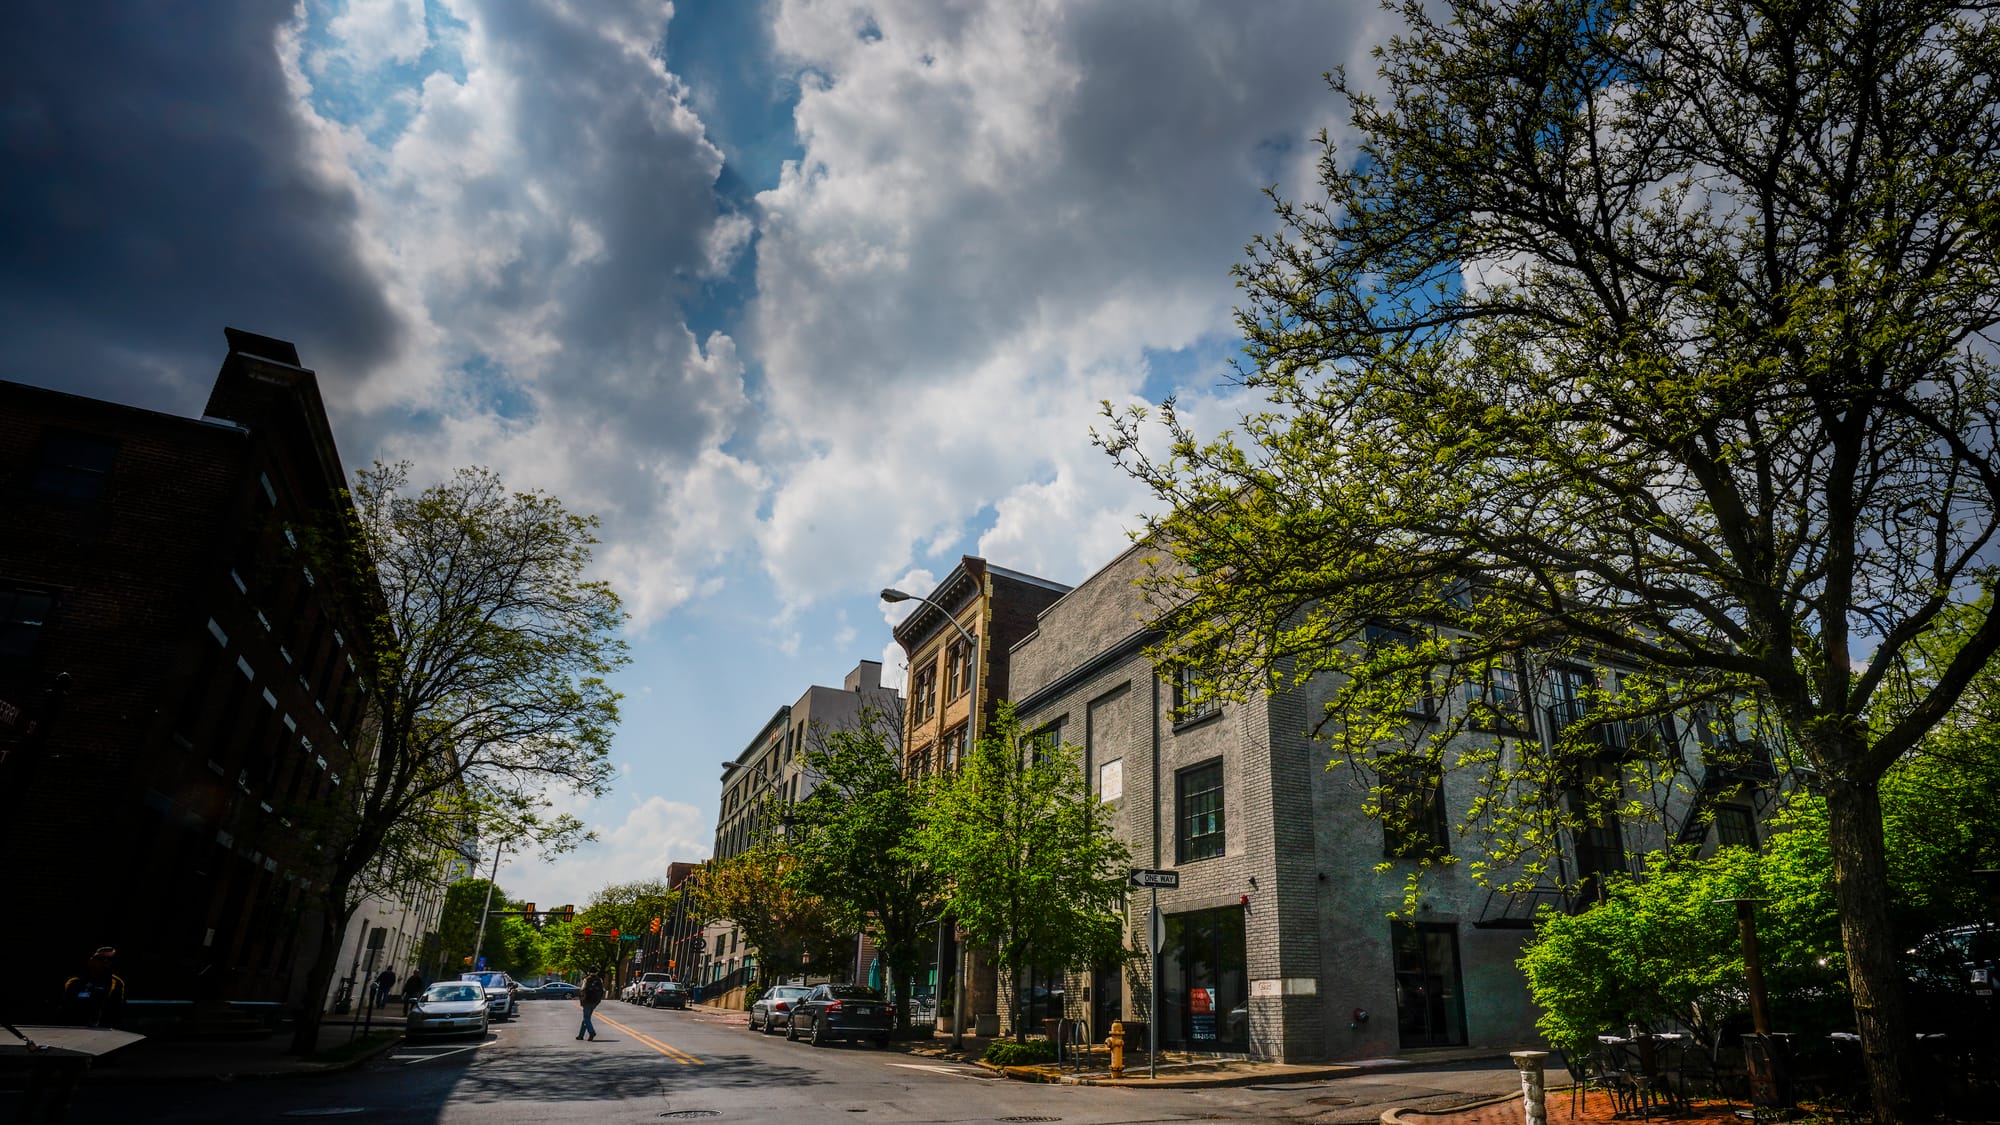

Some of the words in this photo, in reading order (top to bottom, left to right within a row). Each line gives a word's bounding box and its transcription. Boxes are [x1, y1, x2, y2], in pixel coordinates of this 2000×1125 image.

[0, 699, 20, 724] ERRY
[1144, 874, 1158, 882] ONE
[1159, 875, 1174, 883] WAY
